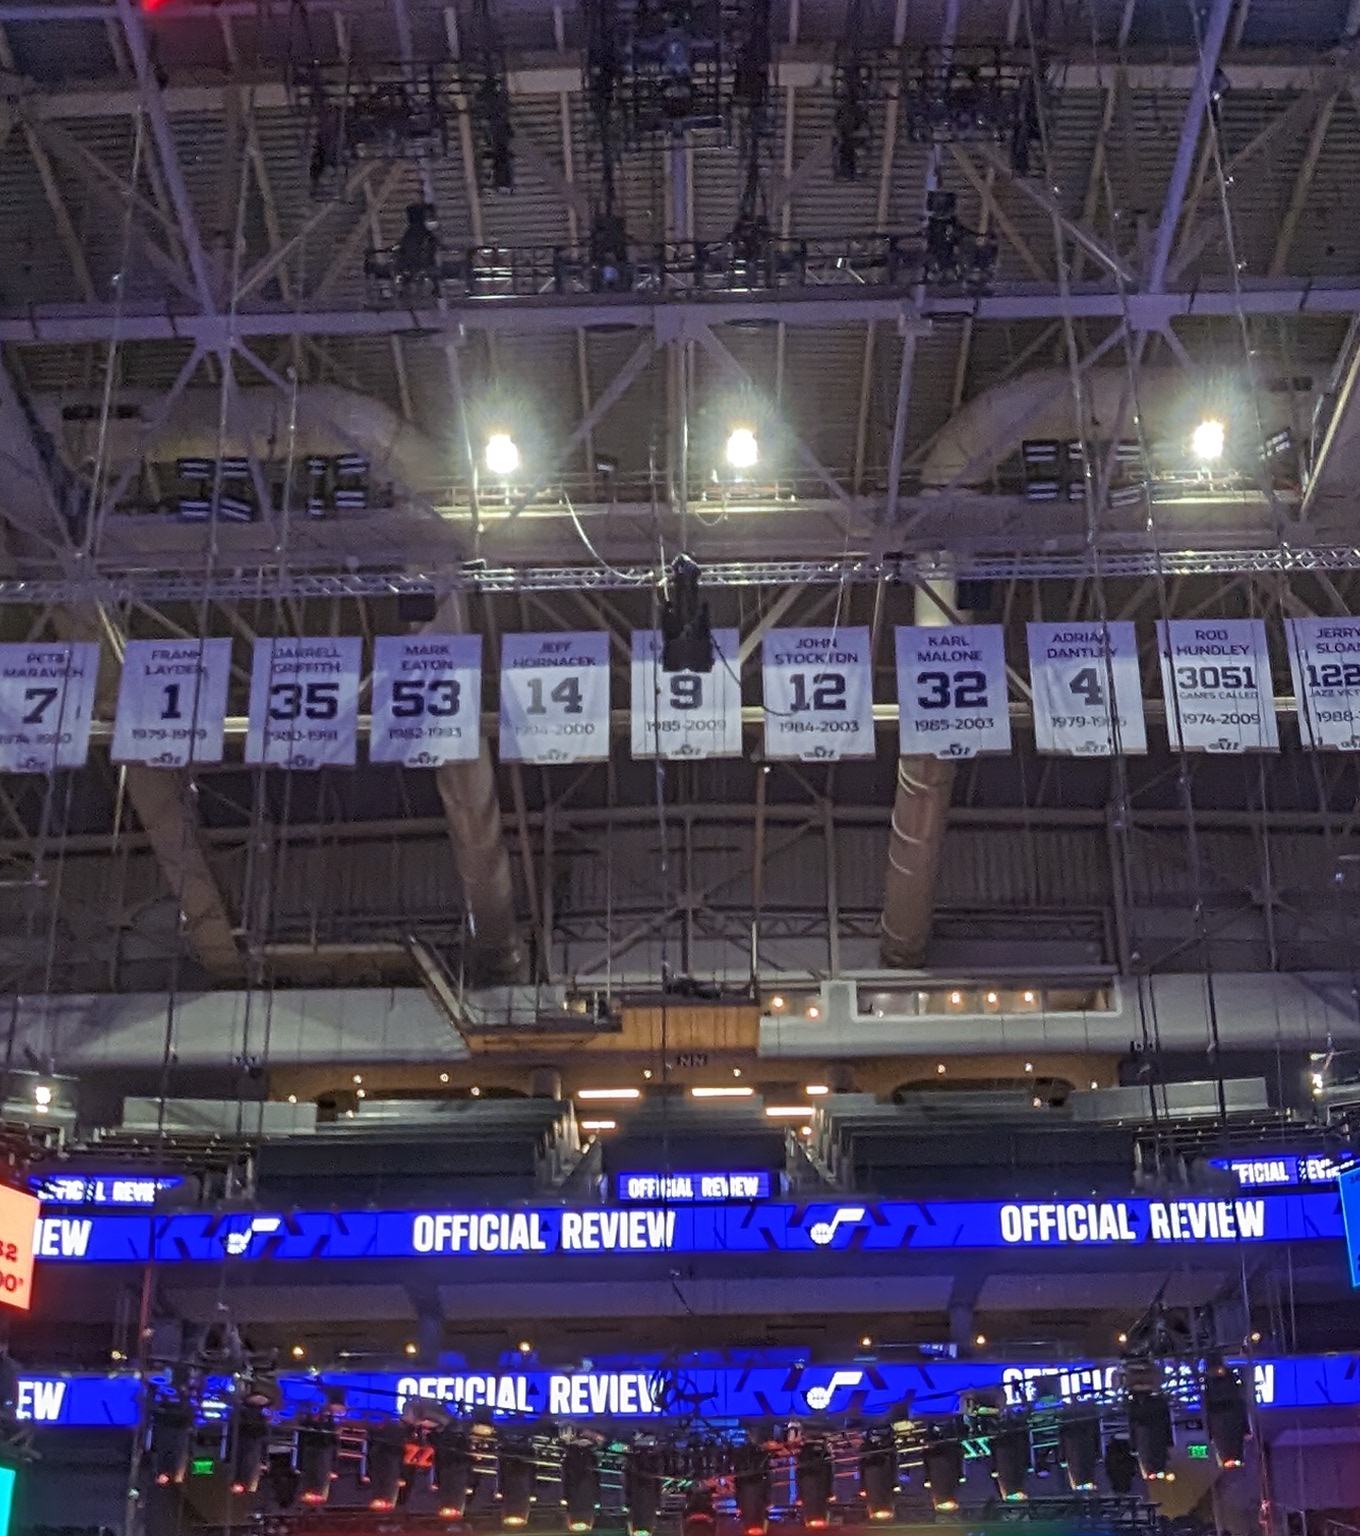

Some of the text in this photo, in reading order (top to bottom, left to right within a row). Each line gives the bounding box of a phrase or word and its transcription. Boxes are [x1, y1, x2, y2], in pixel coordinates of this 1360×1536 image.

[796, 638, 838, 649] JOHN
[928, 636, 970, 647] KARL
[1195, 629, 1228, 641] ROD
[405, 645, 449, 656] MARK
[775, 653, 859, 665] STOCKTON
[917, 651, 983, 662] MALONE
[1177, 645, 1250, 657] HUNDLEY
[402, 660, 453, 671] EATON
[1070, 667, 1104, 706] 4
[1177, 666, 1257, 690] 3051
[161, 683, 181, 720] 1
[269, 682, 339, 721] 35
[391, 680, 461, 718] 53
[526, 676, 583, 716] 14
[669, 674, 703, 710] 9
[790, 673, 846, 712] 12
[917, 671, 988, 710] 32
[23, 687, 58, 724] 7
[646, 719, 727, 732] 1985-2009
[780, 720, 859, 733] 1984-2003
[915, 718, 994, 731] 1985-2003
[1182, 713, 1261, 725] 1974-2009
[627, 1176, 758, 1199] OFFICIAL REVIEW
[412, 1211, 676, 1254] OFFICIAL REVIEW
[1000, 1200, 1266, 1244] OFFICIAL REVIEW
